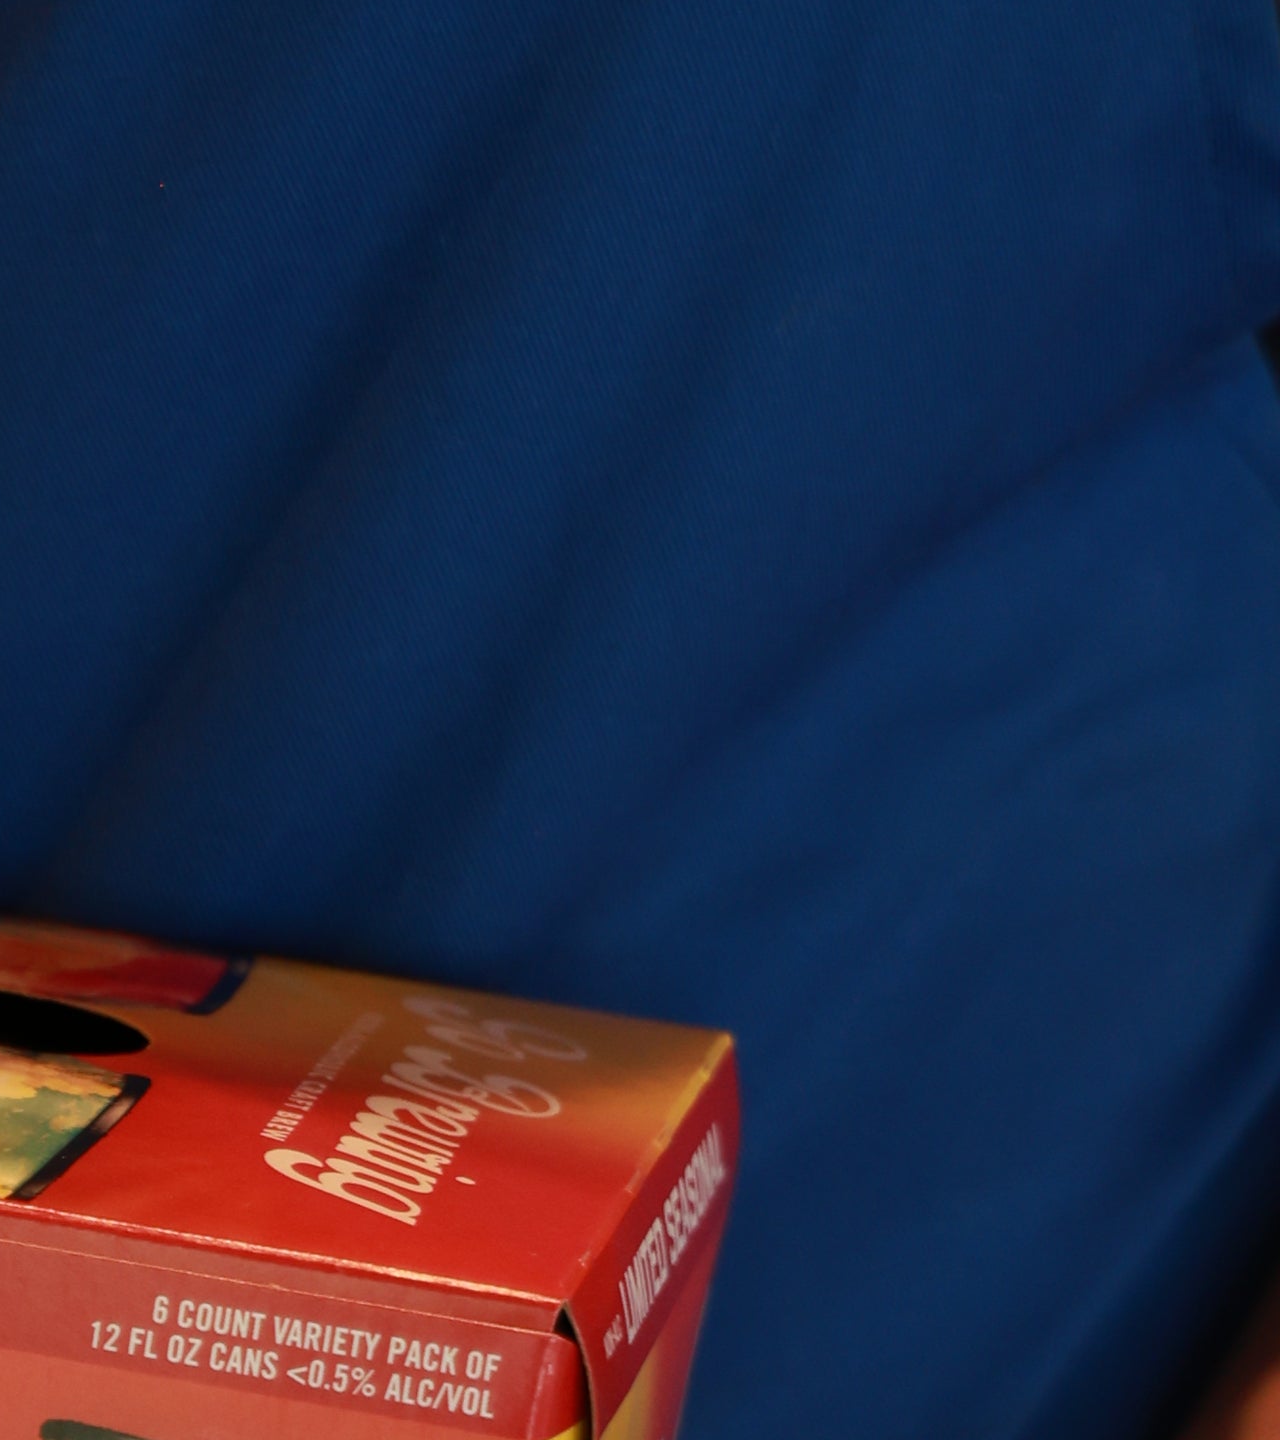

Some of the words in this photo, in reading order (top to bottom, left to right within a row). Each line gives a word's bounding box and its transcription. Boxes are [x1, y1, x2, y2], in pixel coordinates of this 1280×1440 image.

[90, 1320, 119, 1353] 12
[128, 1327, 157, 1360] FL
[167, 1334, 202, 1368] OZ
[209, 1341, 279, 1381] CANS
[286, 1360, 376, 1398] <0.5%
[384, 1374, 495, 1419] ALC/VOL
[152, 1295, 169, 1325] 6
[178, 1299, 266, 1341] COUNT
[274, 1317, 381, 1361] VARIETY
[387, 1336, 458, 1375] PACK
[466, 1350, 502, 1383] OF
